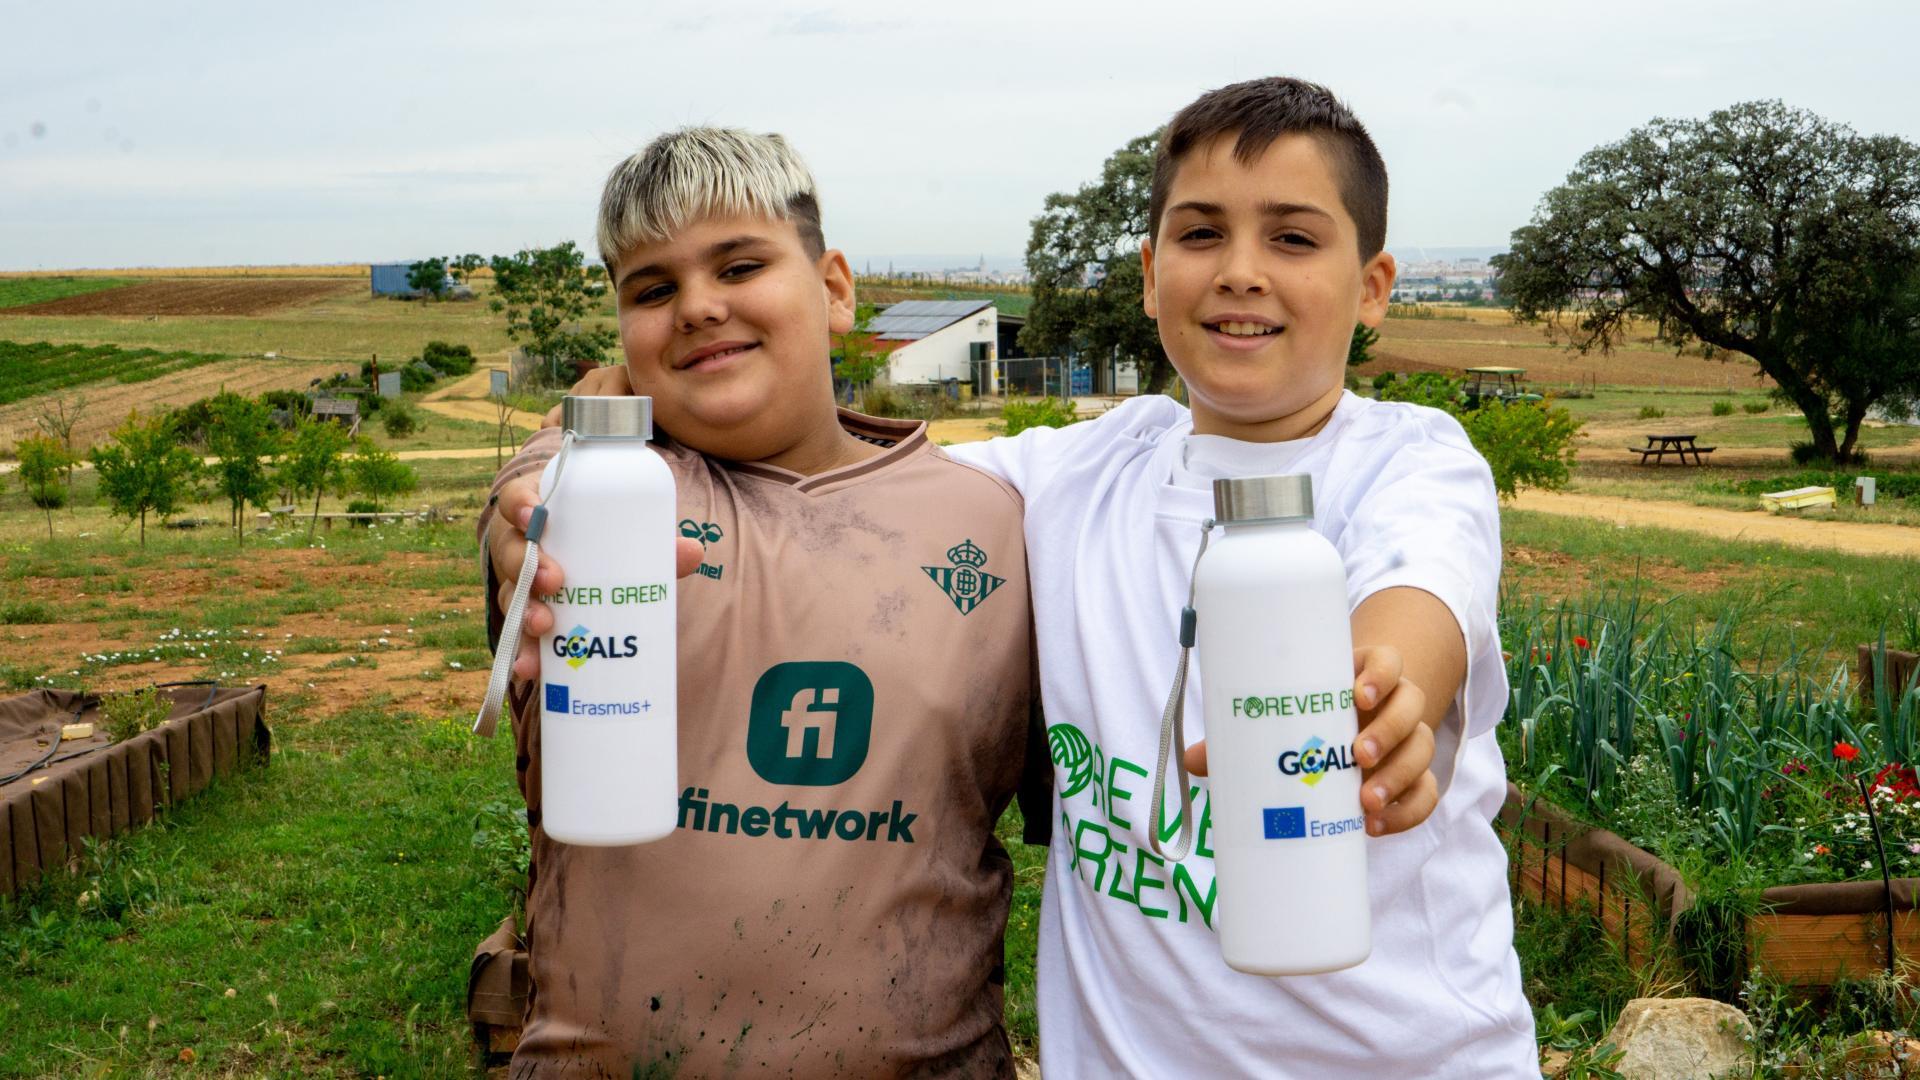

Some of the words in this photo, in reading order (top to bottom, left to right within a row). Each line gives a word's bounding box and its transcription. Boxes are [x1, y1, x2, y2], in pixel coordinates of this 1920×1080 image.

[612, 584, 667, 605] GREEN
[553, 634, 638, 660] GOALS
[572, 700, 652, 716] Erasmus+
[1233, 692, 1334, 718] FOREVER
[781, 688, 840, 759] fi
[678, 787, 918, 843] finetwork
